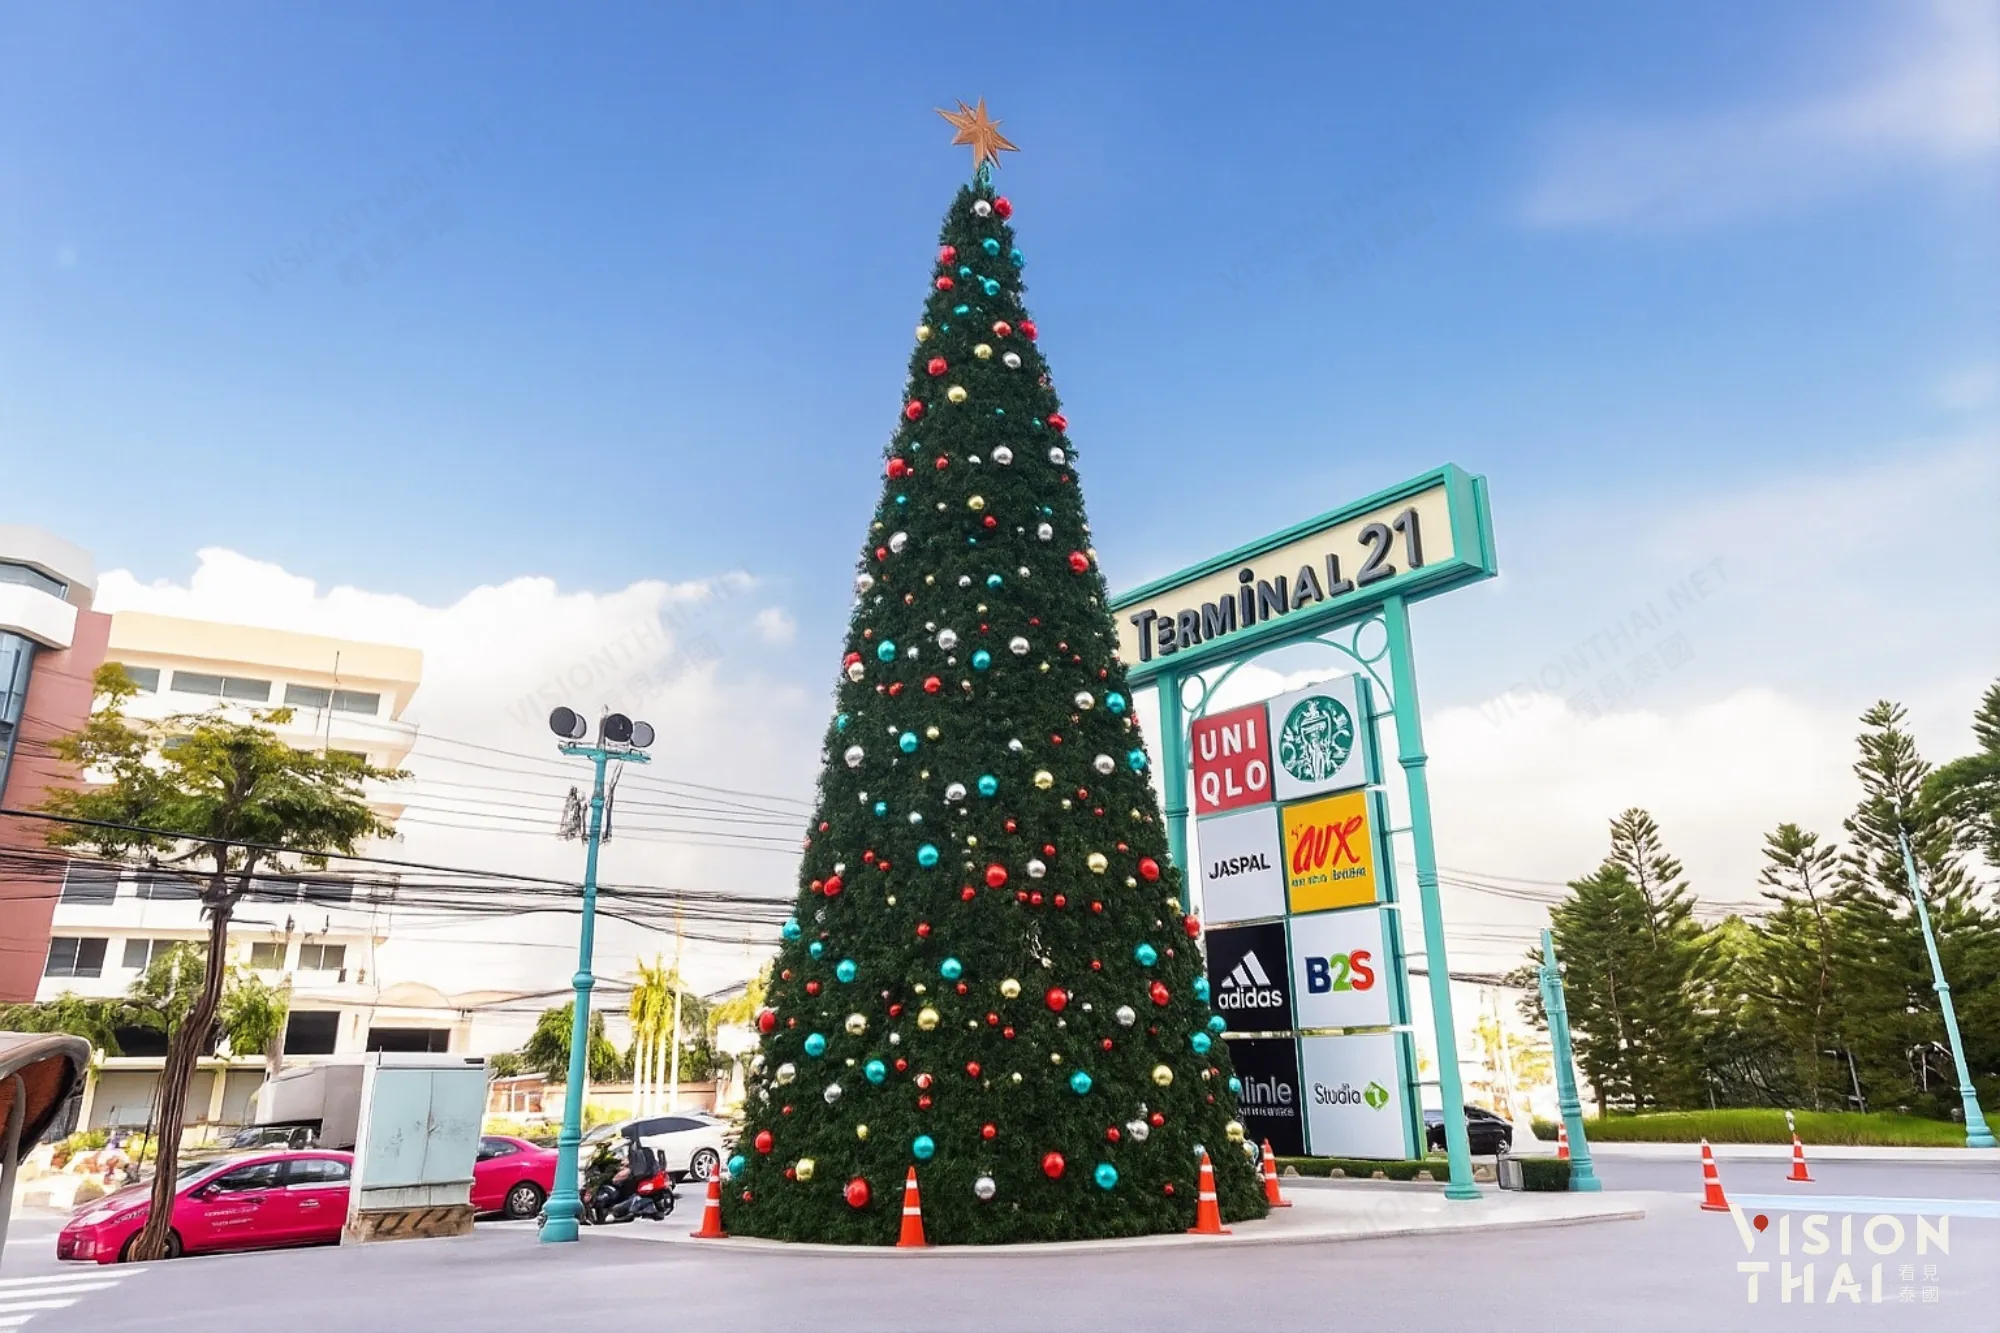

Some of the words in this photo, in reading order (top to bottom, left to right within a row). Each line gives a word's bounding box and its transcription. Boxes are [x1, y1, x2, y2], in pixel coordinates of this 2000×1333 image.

[1357, 507, 1424, 588] 21
[1200, 718, 1256, 761] UNI
[1201, 759, 1267, 806] QLO
[1209, 853, 1271, 880] JASPAL
[1305, 949, 1375, 994] B2S
[1218, 988, 1283, 1009] adidas
